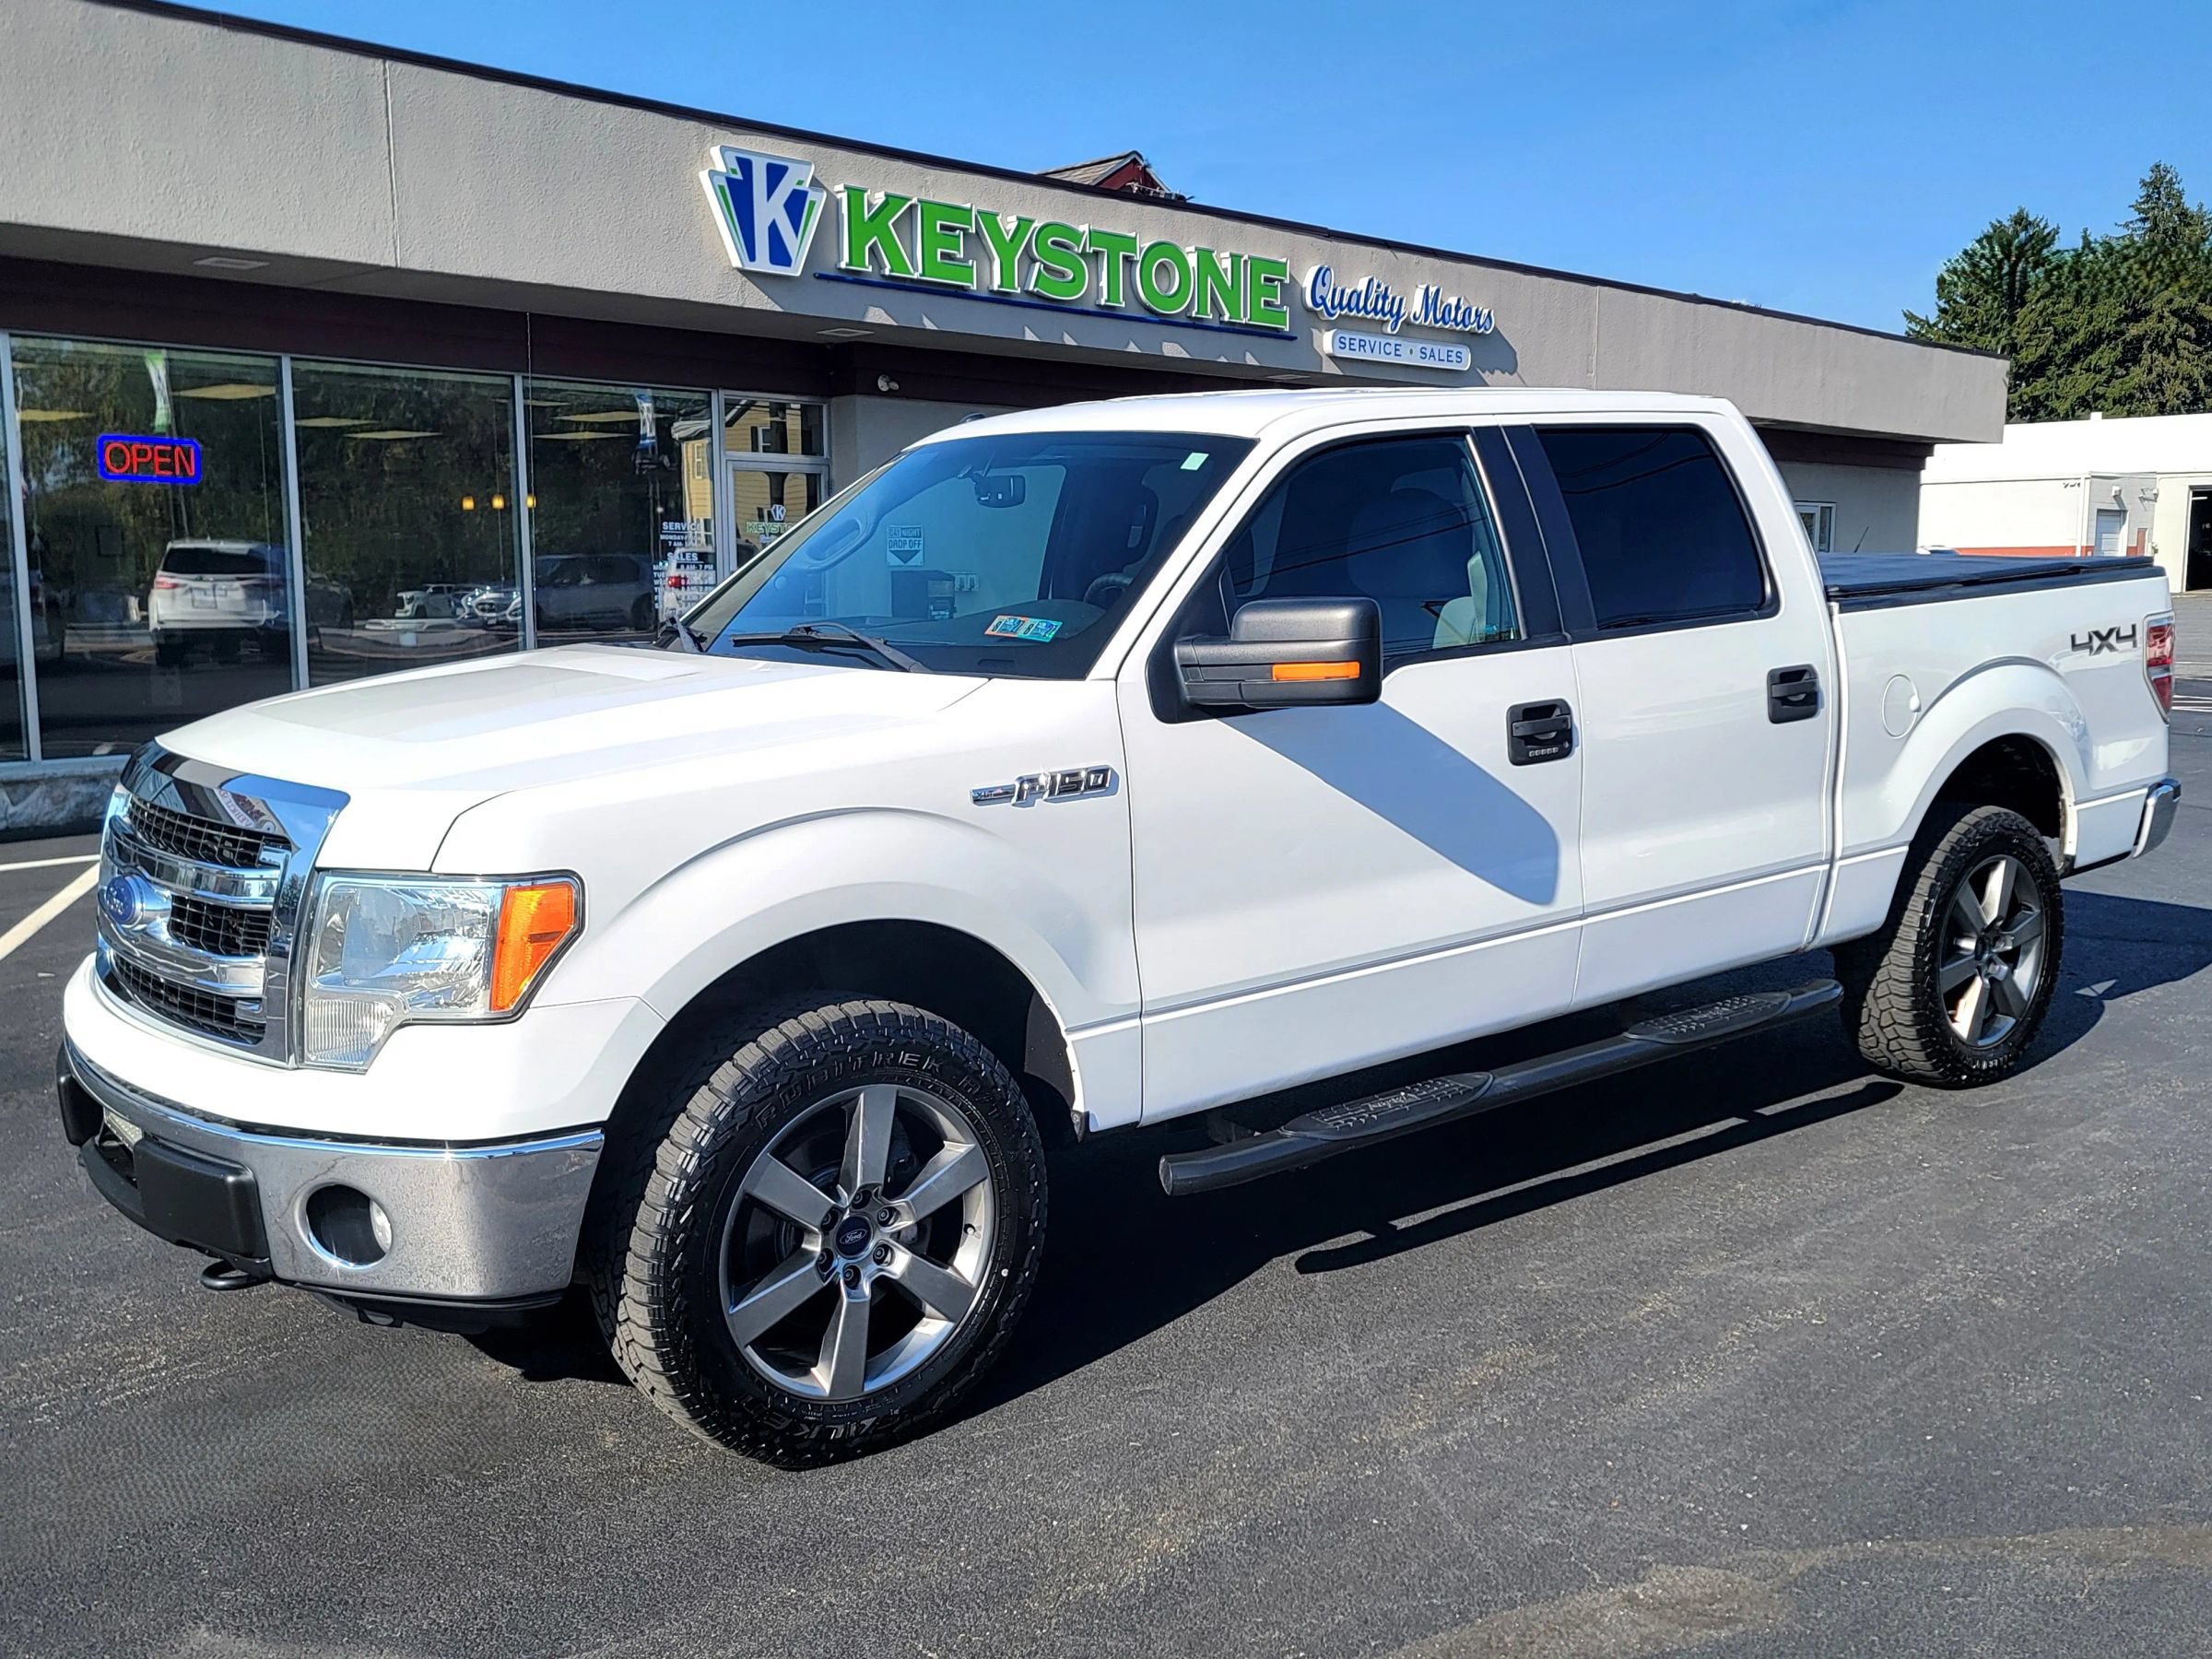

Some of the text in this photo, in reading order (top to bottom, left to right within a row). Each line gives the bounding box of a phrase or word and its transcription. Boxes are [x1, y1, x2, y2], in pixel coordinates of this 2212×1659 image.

[834, 182, 1290, 332] KEYSTONE
[1307, 264, 1495, 334] Quality Motors
[1337, 335, 1464, 364] SERVICE SALES
[104, 441, 196, 477] OPEN
[888, 527, 901, 537] DAY
[888, 539, 922, 549] DROP OFF
[666, 552, 699, 561] SALES
[1011, 764, 1120, 808] F-150
[842, 1230, 865, 1243] Ford
